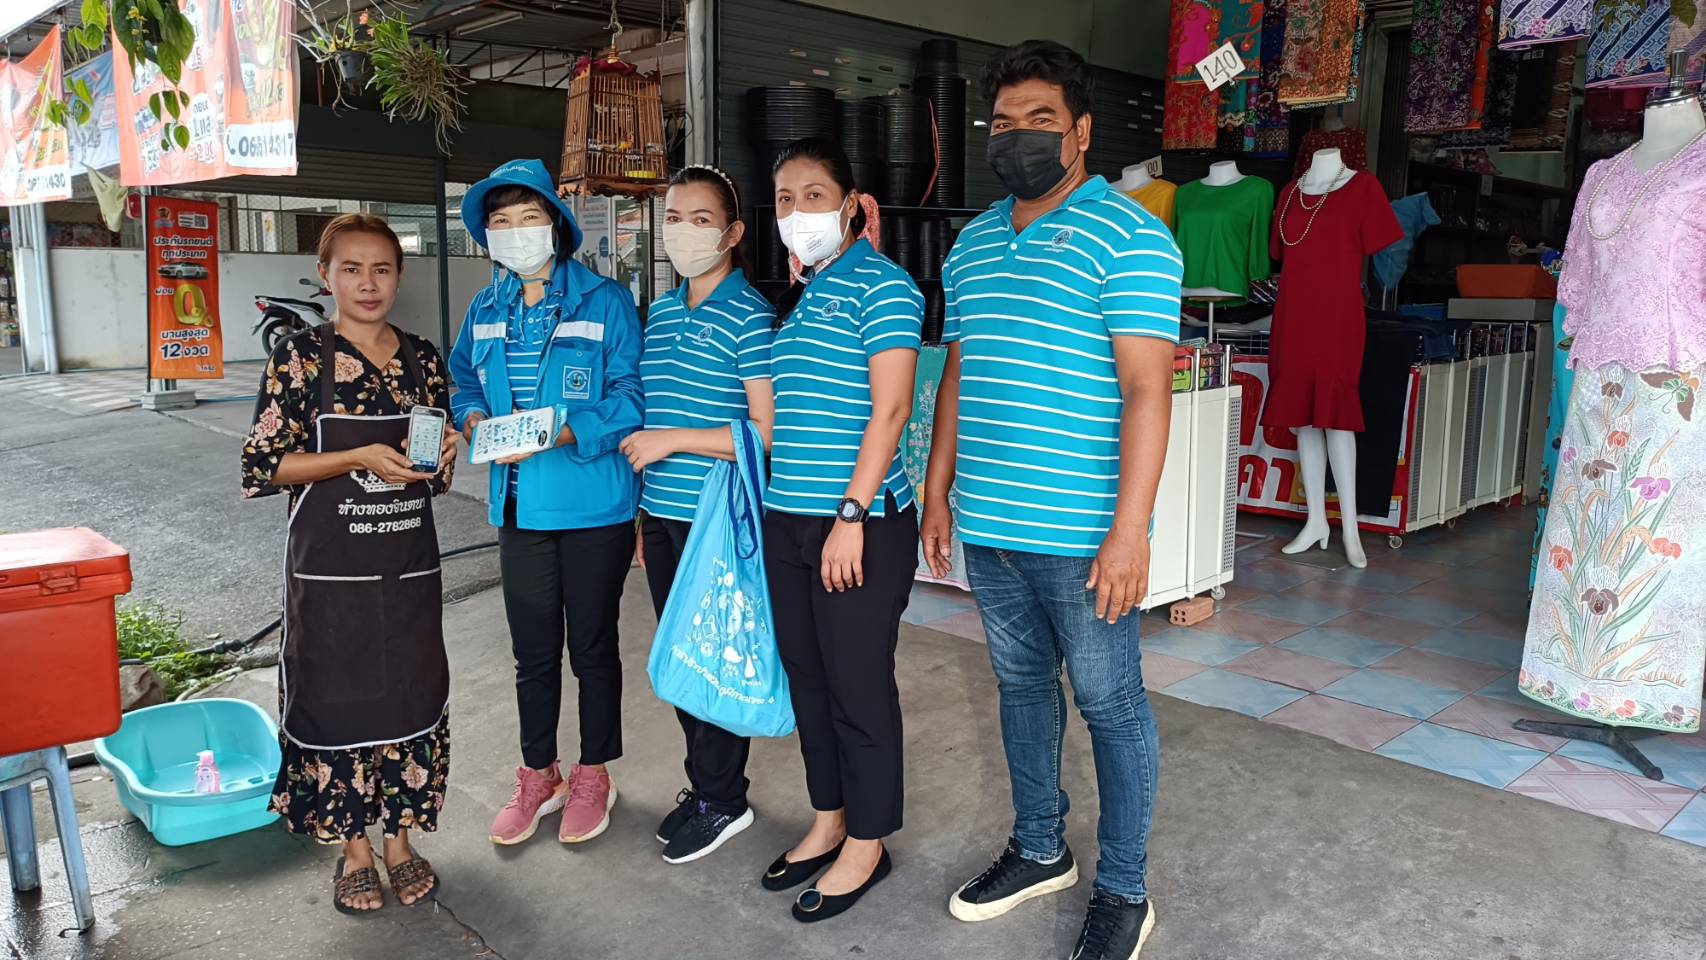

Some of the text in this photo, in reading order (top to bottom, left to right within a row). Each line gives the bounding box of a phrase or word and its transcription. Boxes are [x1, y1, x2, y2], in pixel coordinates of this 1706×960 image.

[1203, 49, 1238, 83] 140
[1144, 160, 1159, 174] 00
[153, 235, 213, 247] ประกันรถยนต์
[162, 249, 207, 260] ทุกประเภท
[161, 329, 209, 341] นานสูงสุด
[349, 517, 421, 534] 086-2782868
